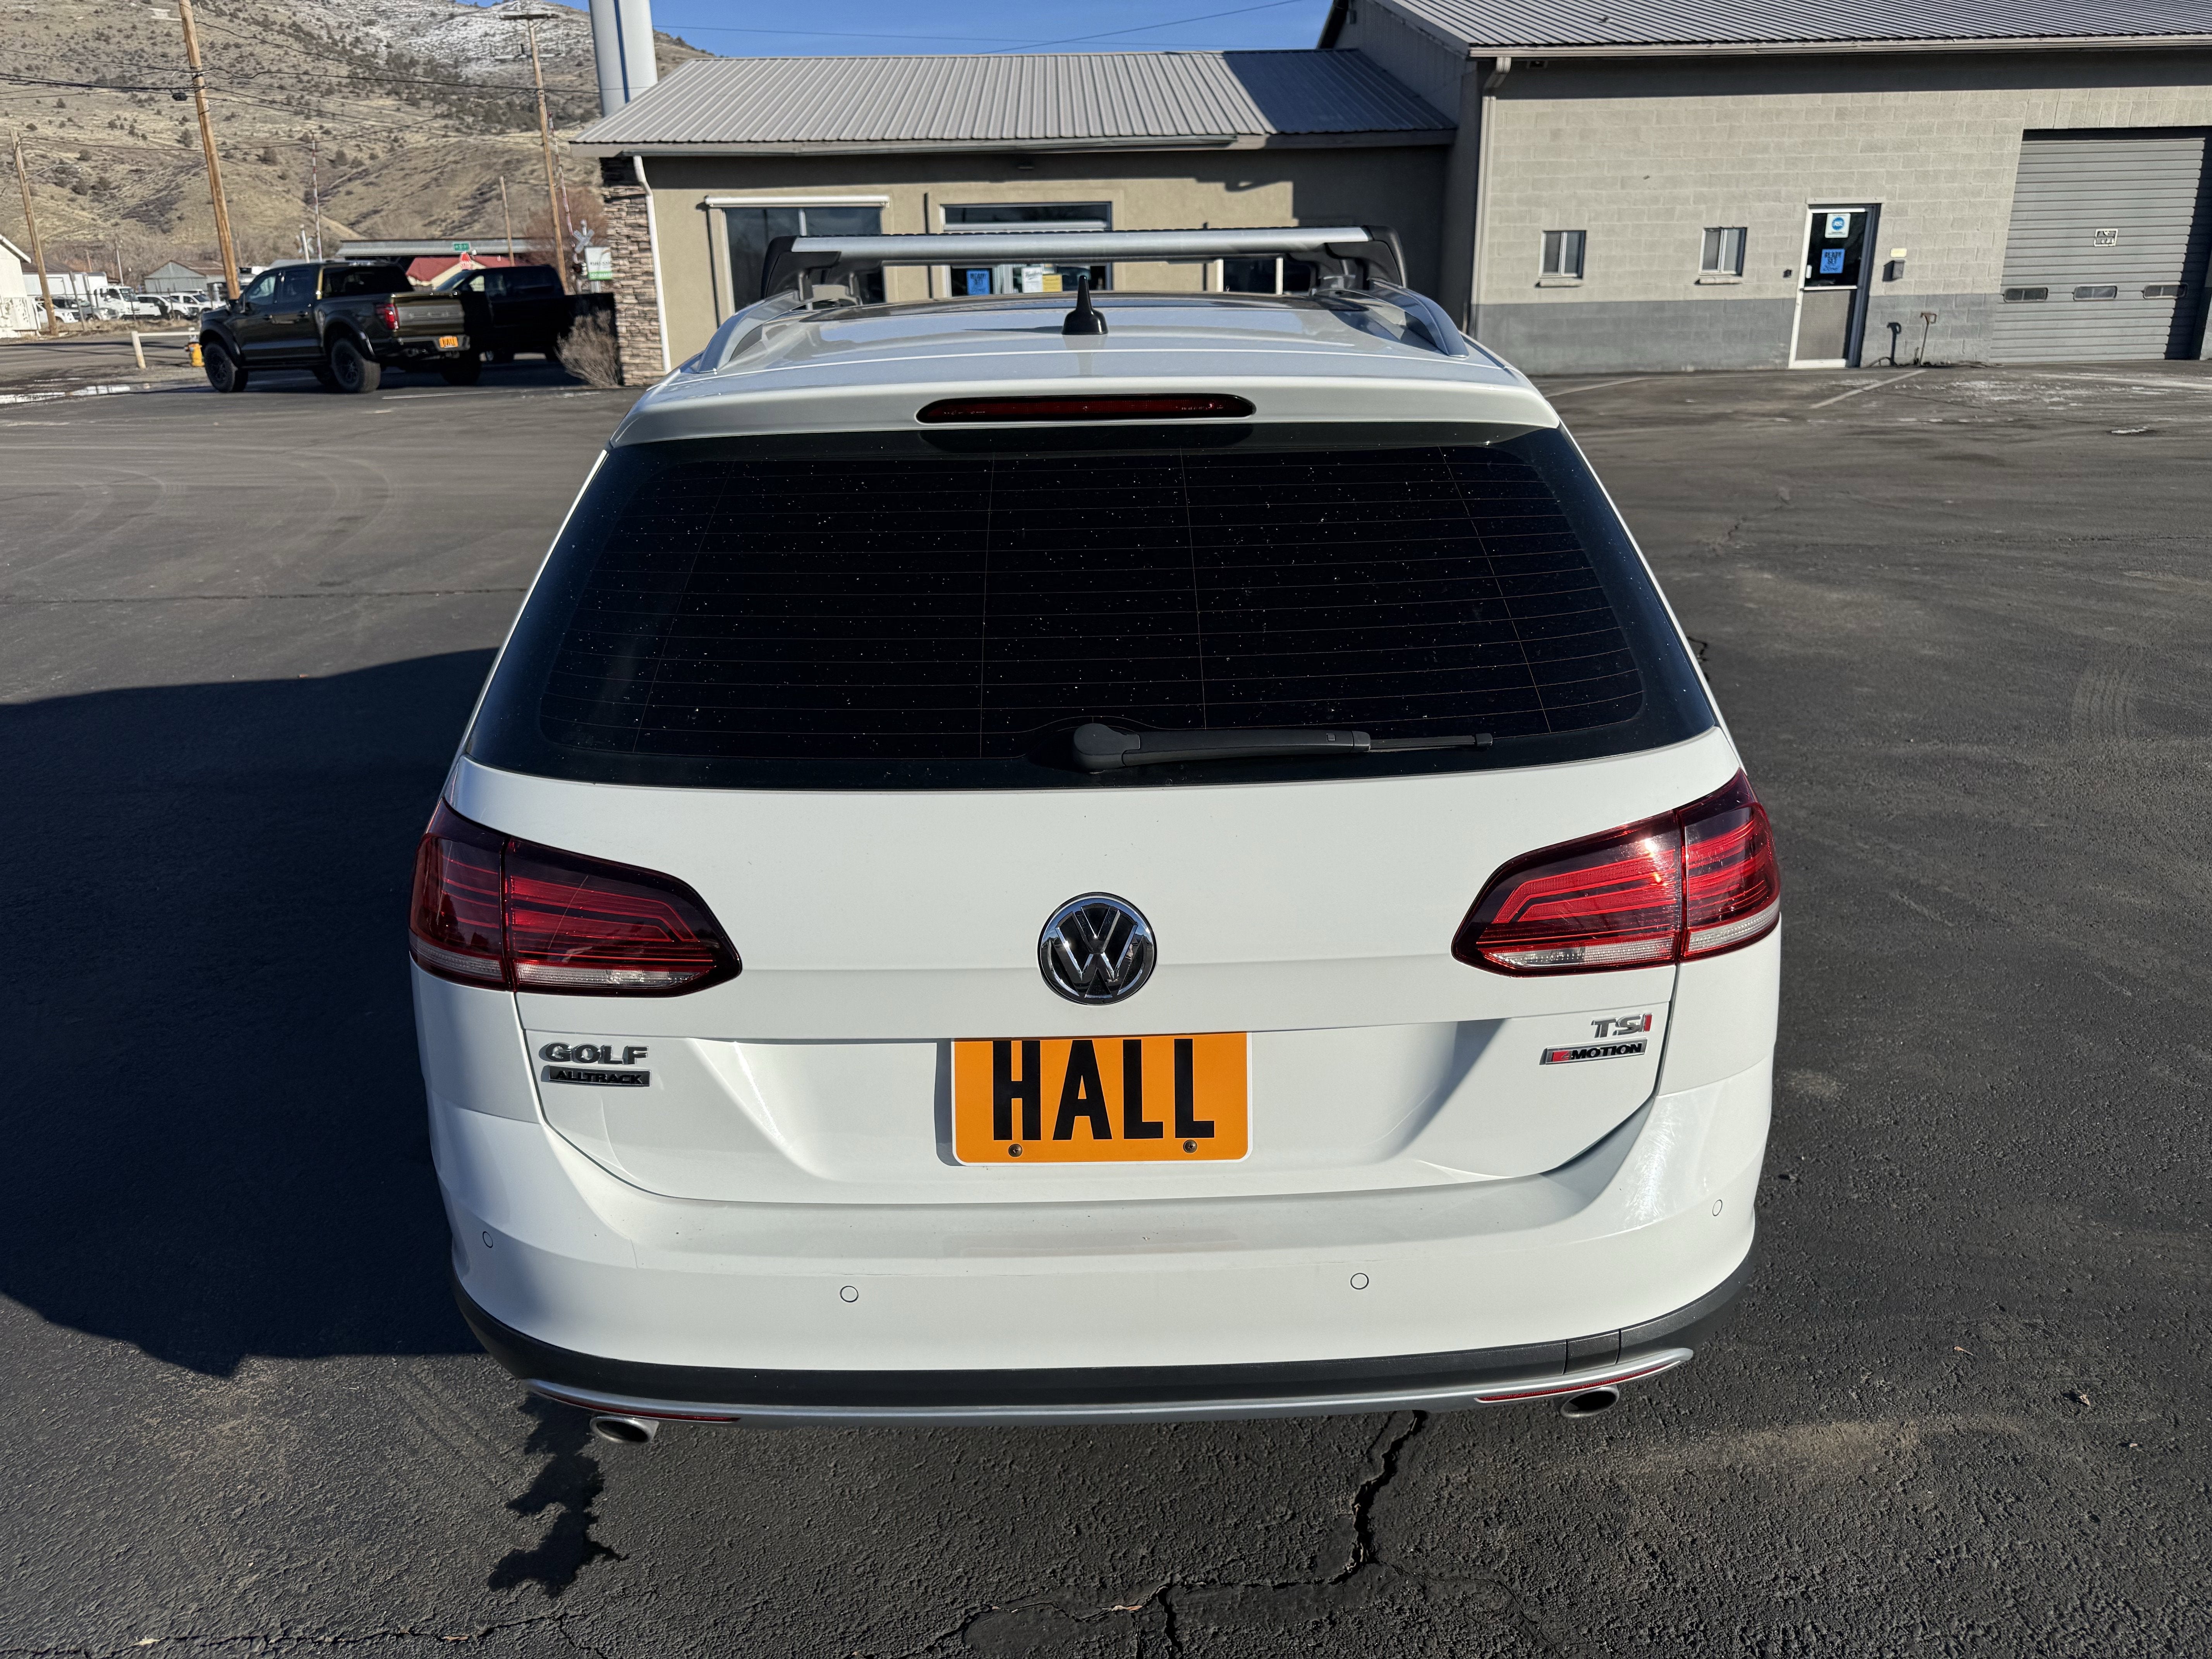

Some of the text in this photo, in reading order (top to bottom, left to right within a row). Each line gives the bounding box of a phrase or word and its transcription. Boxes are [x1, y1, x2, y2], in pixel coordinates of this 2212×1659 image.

[1591, 1013, 1652, 1038] TSI
[545, 1042, 649, 1065] GOLF
[556, 1070, 644, 1085] ALLTRACK
[992, 1039, 1215, 1141] HALL
